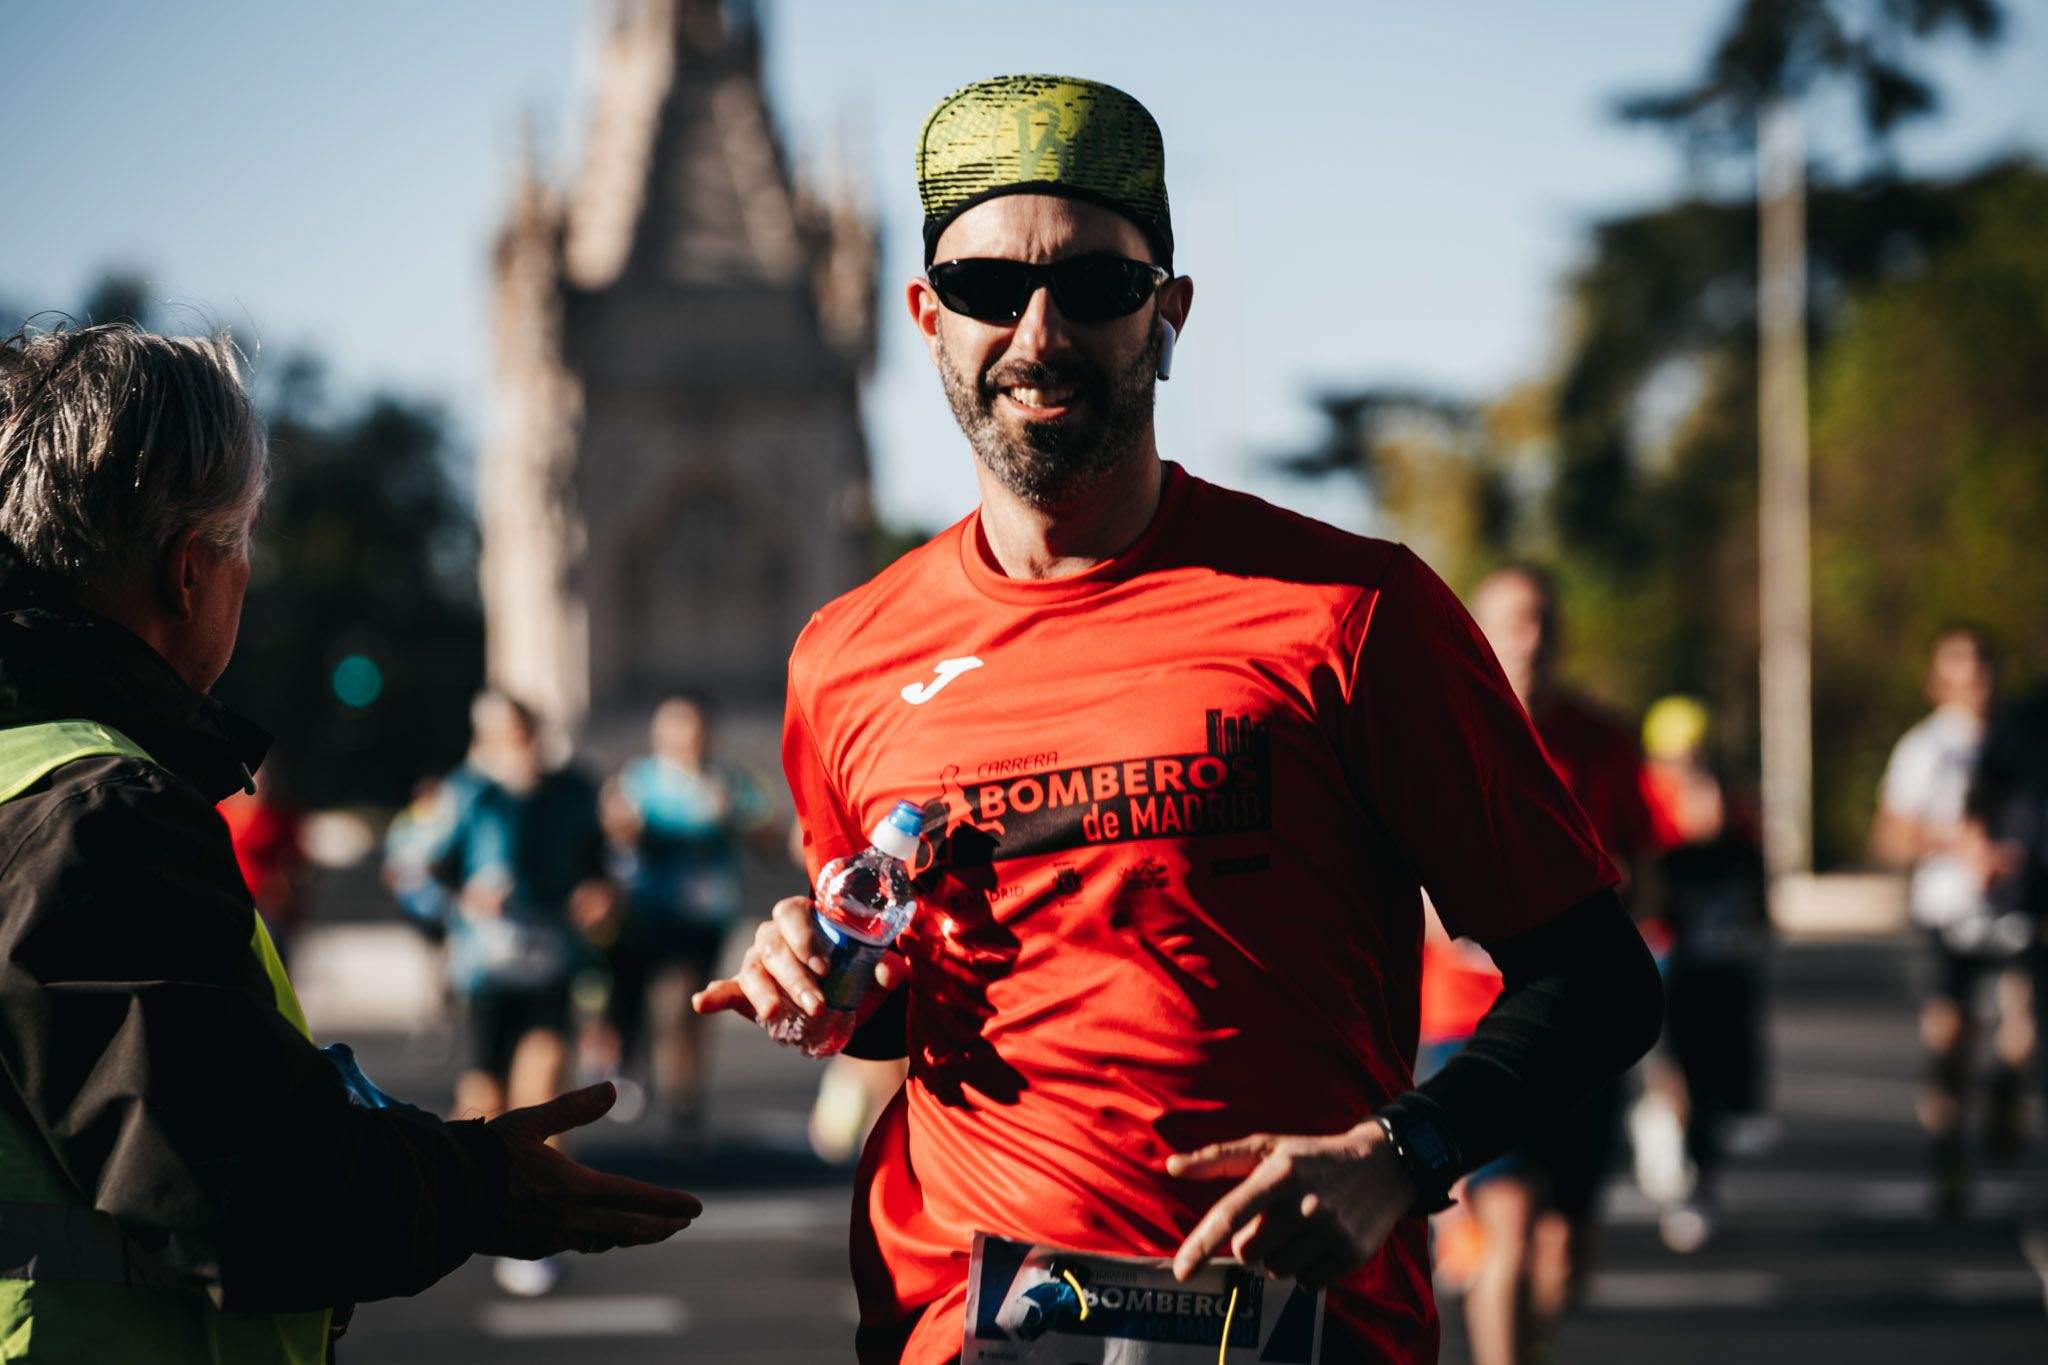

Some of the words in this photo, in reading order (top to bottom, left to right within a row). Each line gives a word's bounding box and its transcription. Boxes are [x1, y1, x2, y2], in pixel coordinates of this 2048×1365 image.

[976, 750, 1058, 778] CARRERA
[979, 755, 1257, 819] BOMBEROS
[1082, 803, 1120, 842] de
[1130, 792, 1258, 838] MADRID
